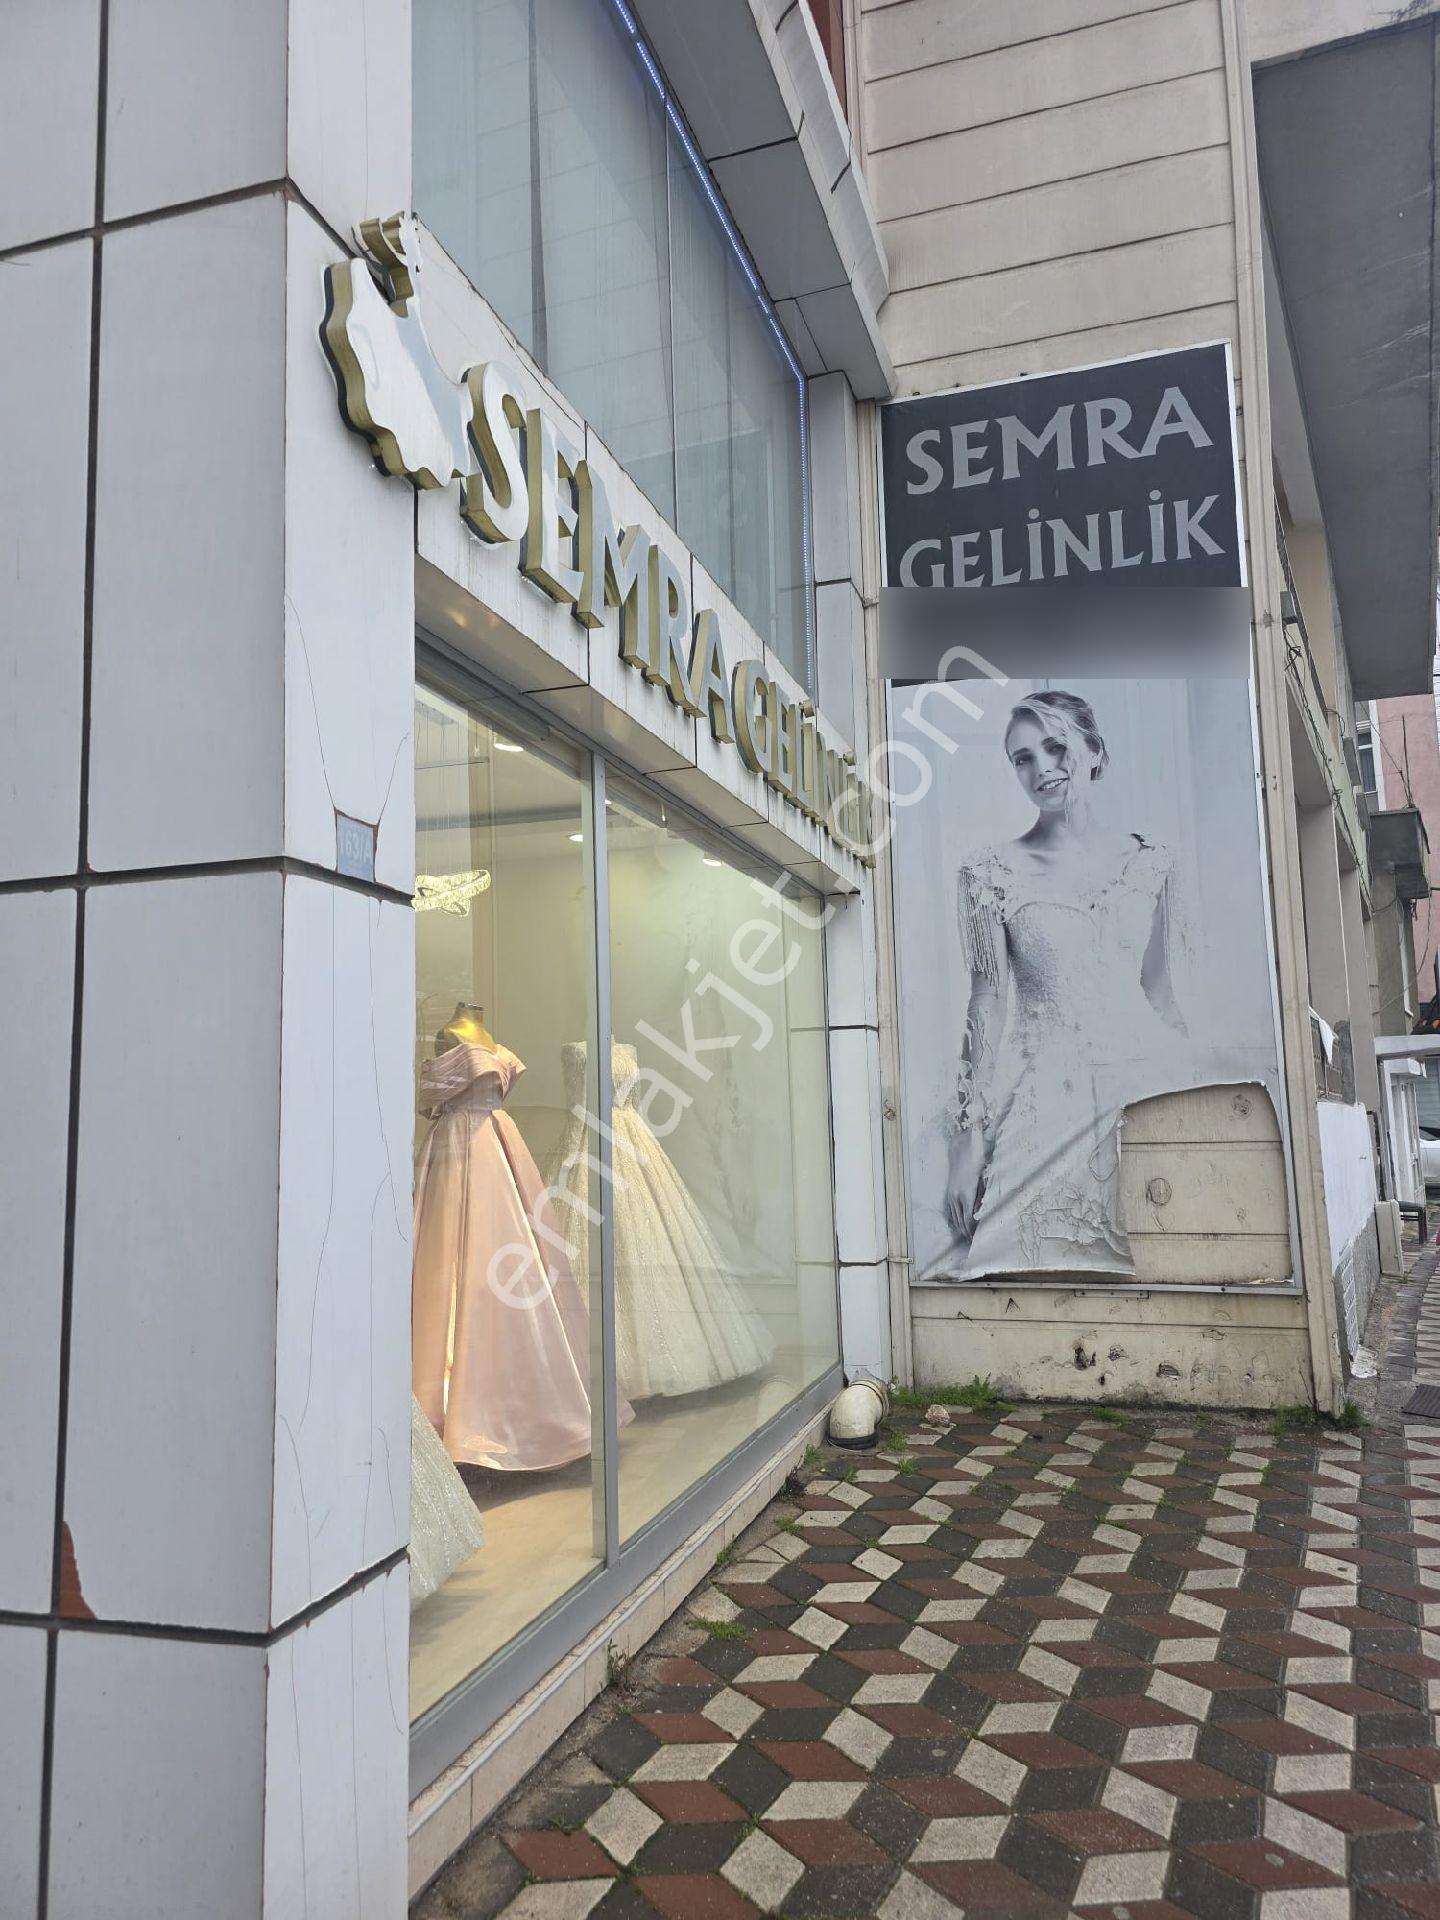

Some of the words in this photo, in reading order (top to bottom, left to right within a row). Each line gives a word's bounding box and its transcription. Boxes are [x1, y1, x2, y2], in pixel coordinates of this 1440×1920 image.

[905, 386, 1213, 496] SEMRA
[459, 361, 736, 742] SEMRA
[899, 489, 1226, 588] GELİNLİK
